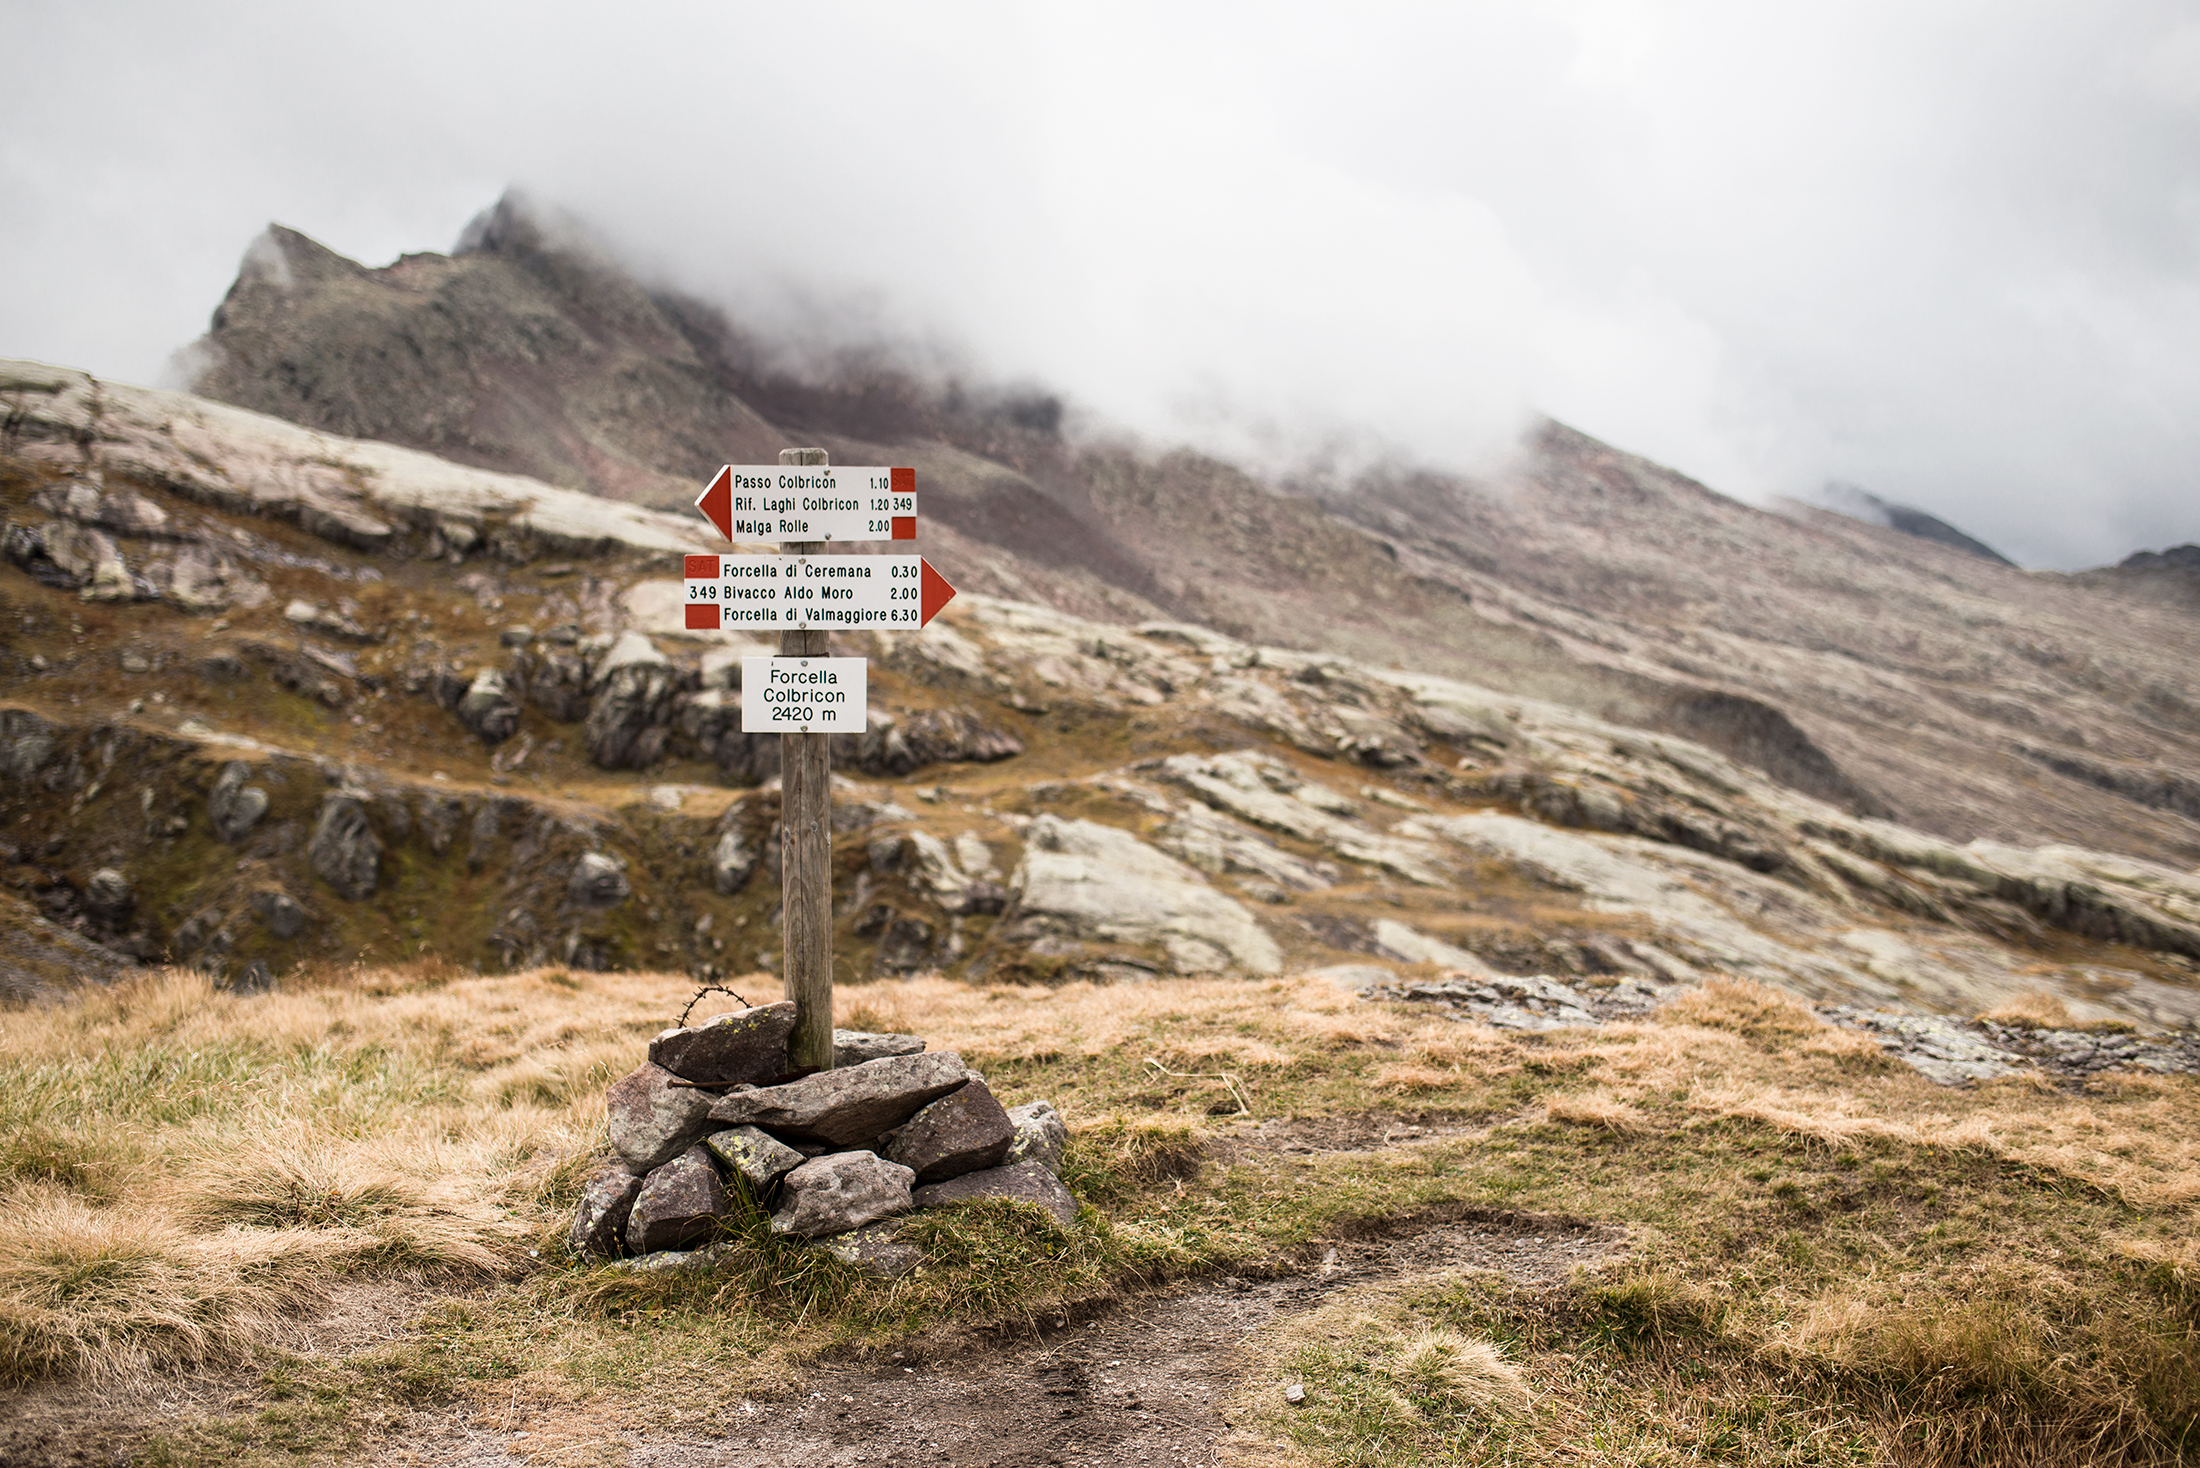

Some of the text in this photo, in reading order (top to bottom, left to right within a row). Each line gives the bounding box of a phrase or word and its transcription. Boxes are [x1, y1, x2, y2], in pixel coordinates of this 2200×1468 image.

[735, 475, 889, 489] Passo Colbricon 1.10
[736, 498, 912, 513] Rif. Laghi Colbricon 1.20 349
[736, 520, 890, 536] Malga Rolle 2.00
[724, 564, 918, 578] Forcella di Ceremana 0.30
[690, 586, 918, 600] 349 Bivacco Aldo Moro 2.00
[724, 608, 918, 623] Forcella di Valmaggiore 6.30
[771, 670, 837, 684] Forcella
[764, 688, 845, 702] Colbricon
[772, 707, 836, 721] 2420 m
